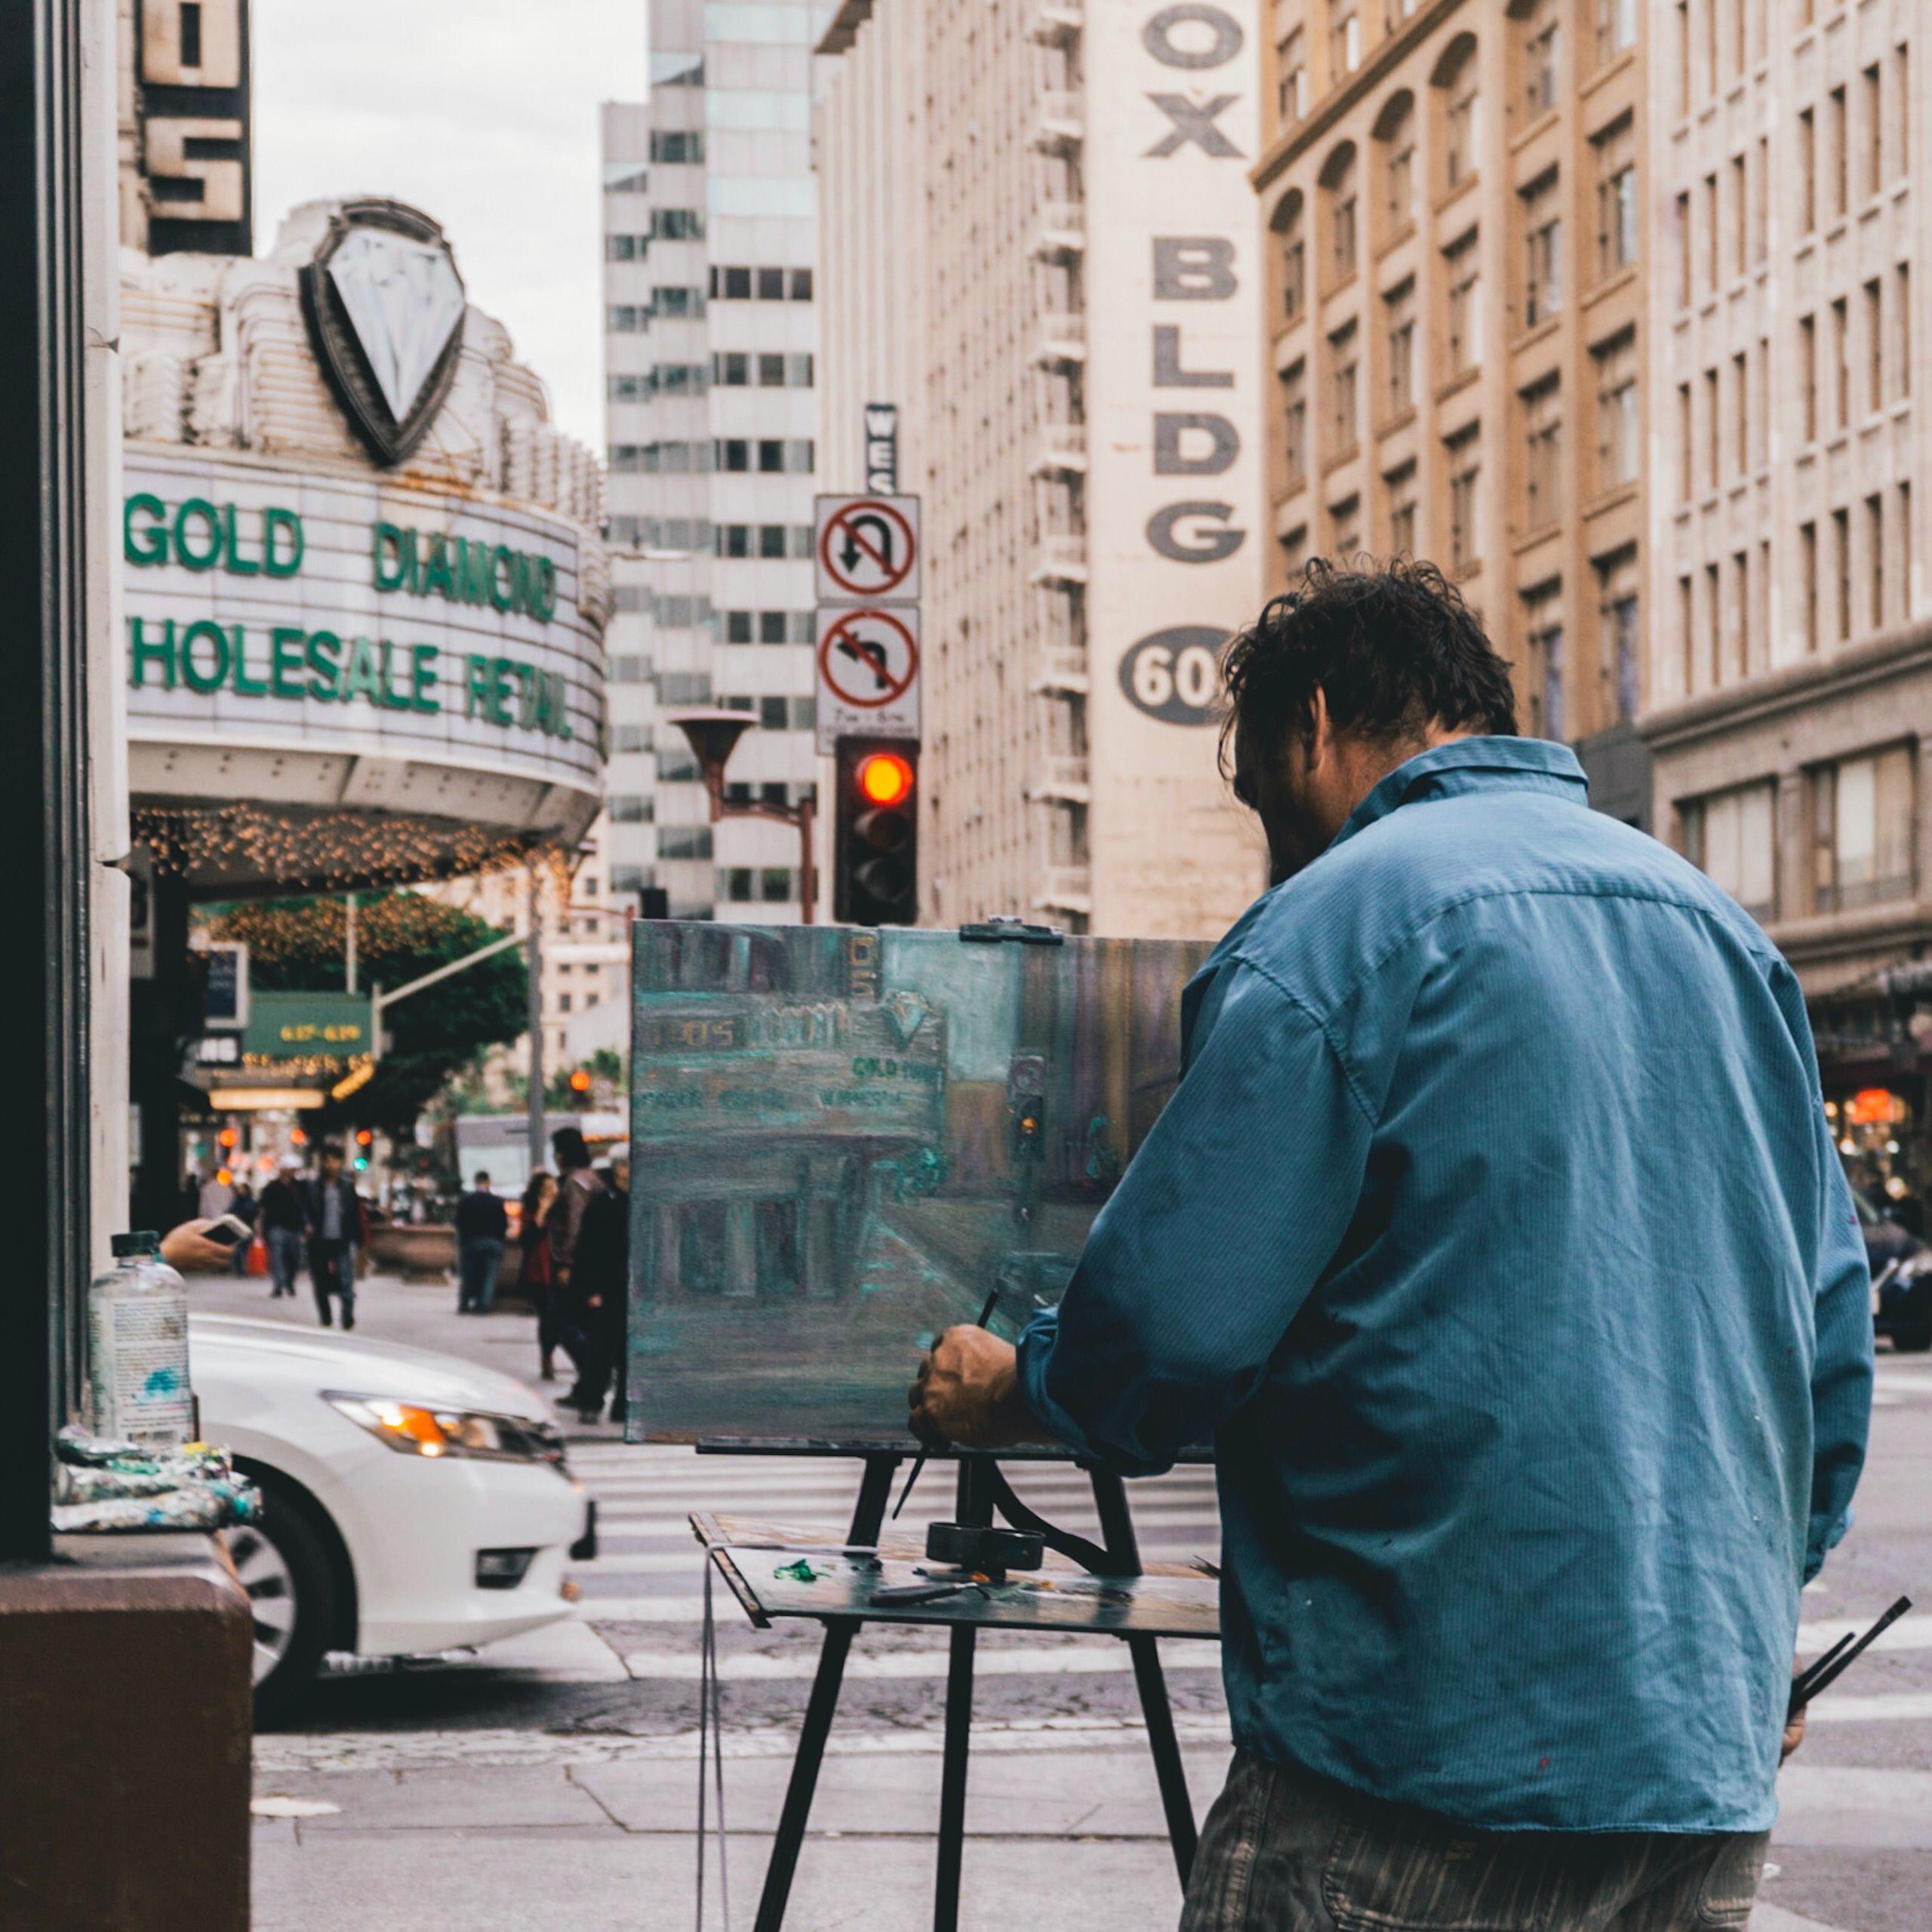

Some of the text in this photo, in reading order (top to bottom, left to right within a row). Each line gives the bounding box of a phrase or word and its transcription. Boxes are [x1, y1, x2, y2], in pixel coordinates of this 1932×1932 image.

[1140, 4, 1247, 564] OX BLDG
[124, 493, 557, 624] GOLD DIAMOND
[125, 615, 440, 713] HOLESALE
[1133, 645, 1224, 709] 60
